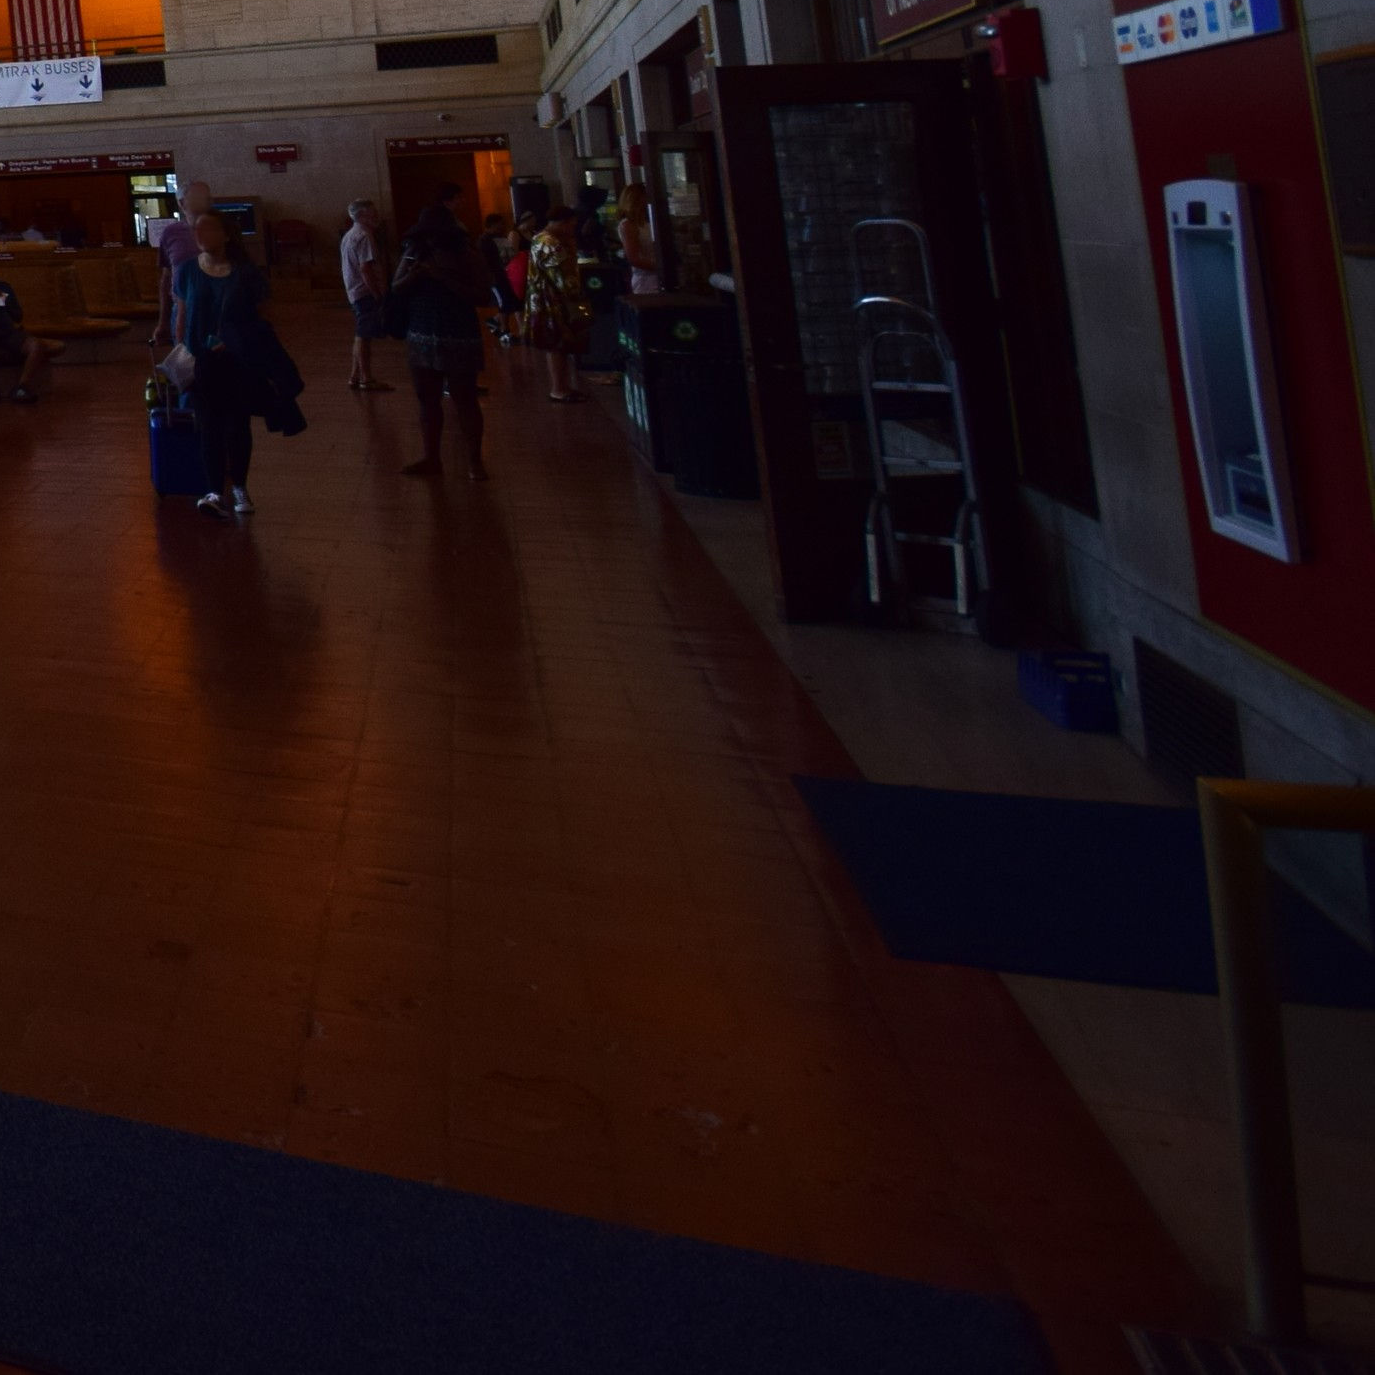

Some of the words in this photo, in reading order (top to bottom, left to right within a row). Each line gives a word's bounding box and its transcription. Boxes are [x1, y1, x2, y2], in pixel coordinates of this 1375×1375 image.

[44, 60, 95, 75] BUSSES
[436, 138, 458, 146] Office
[460, 137, 482, 145] Lobby
